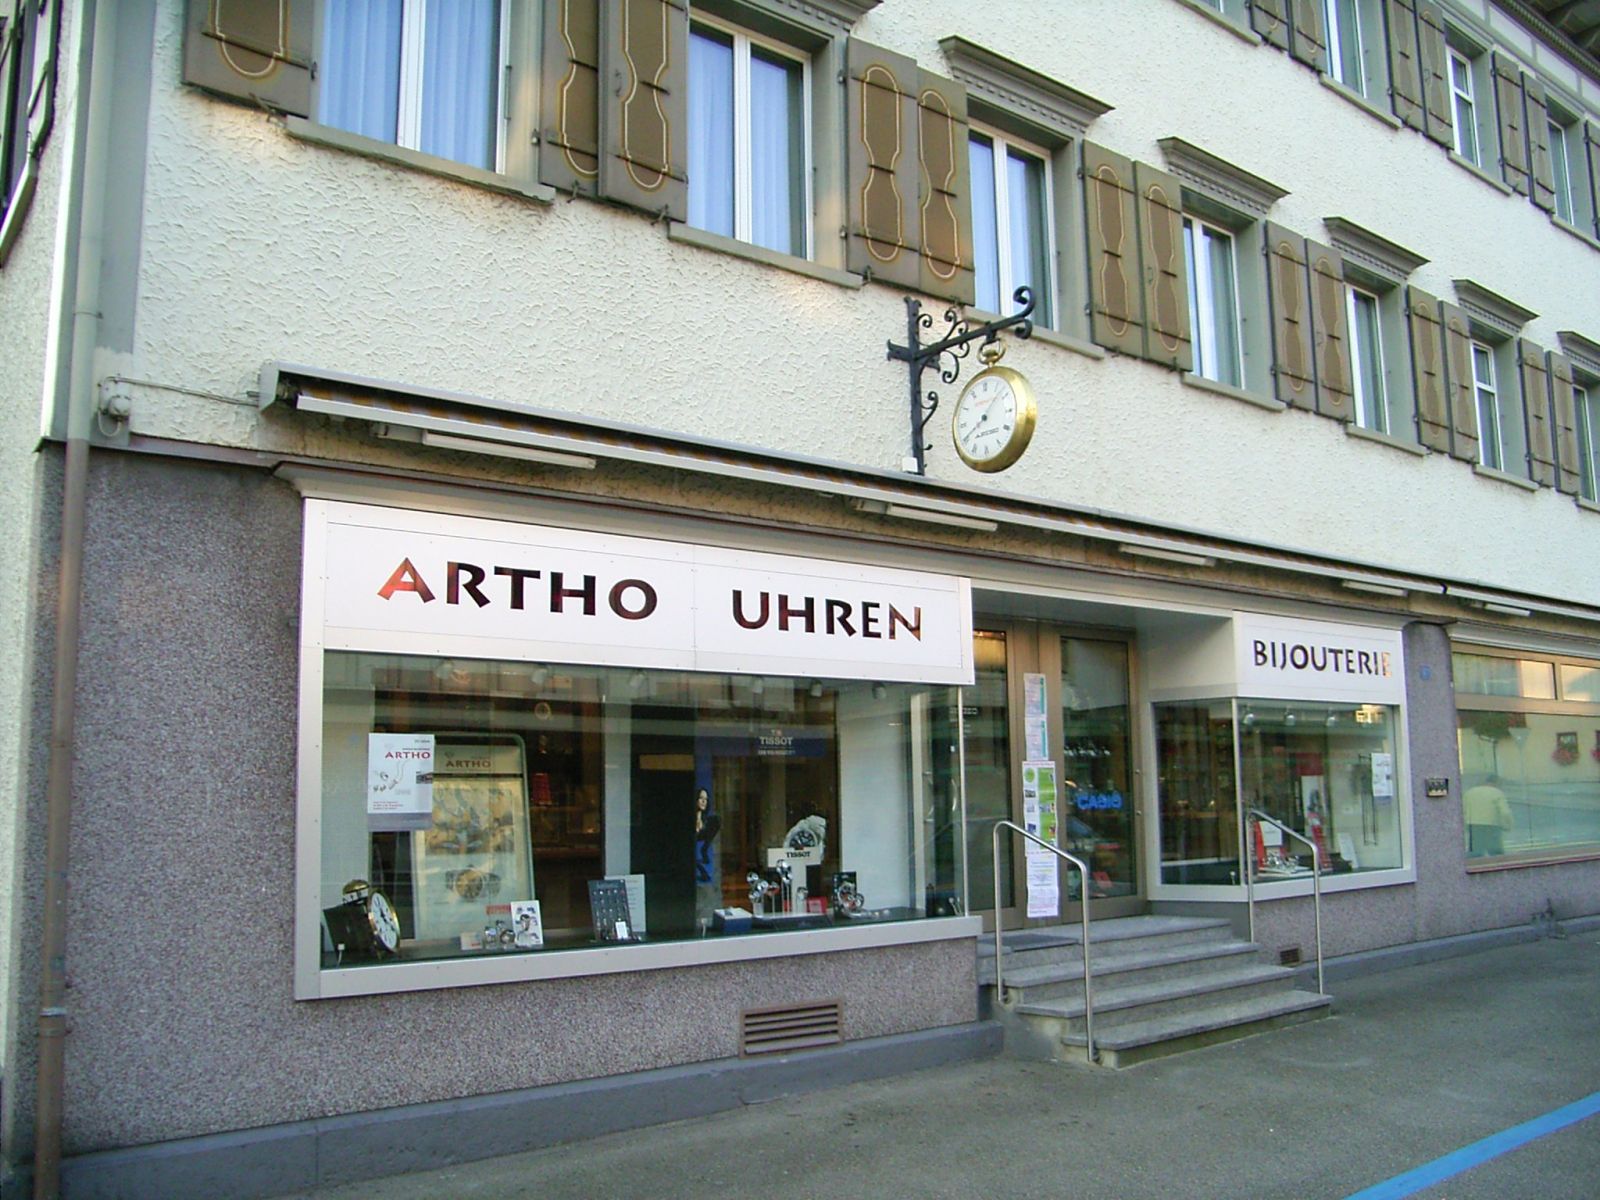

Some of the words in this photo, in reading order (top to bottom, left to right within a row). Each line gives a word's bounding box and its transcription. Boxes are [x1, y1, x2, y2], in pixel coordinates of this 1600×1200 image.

[377, 557, 658, 620] ARTHO
[732, 589, 921, 641] UHREN
[1253, 640, 1392, 678] BIJOUTERIE
[759, 736, 793, 745] TISSOT
[385, 751, 430, 759] ARTHO
[445, 760, 491, 768] ARTHO
